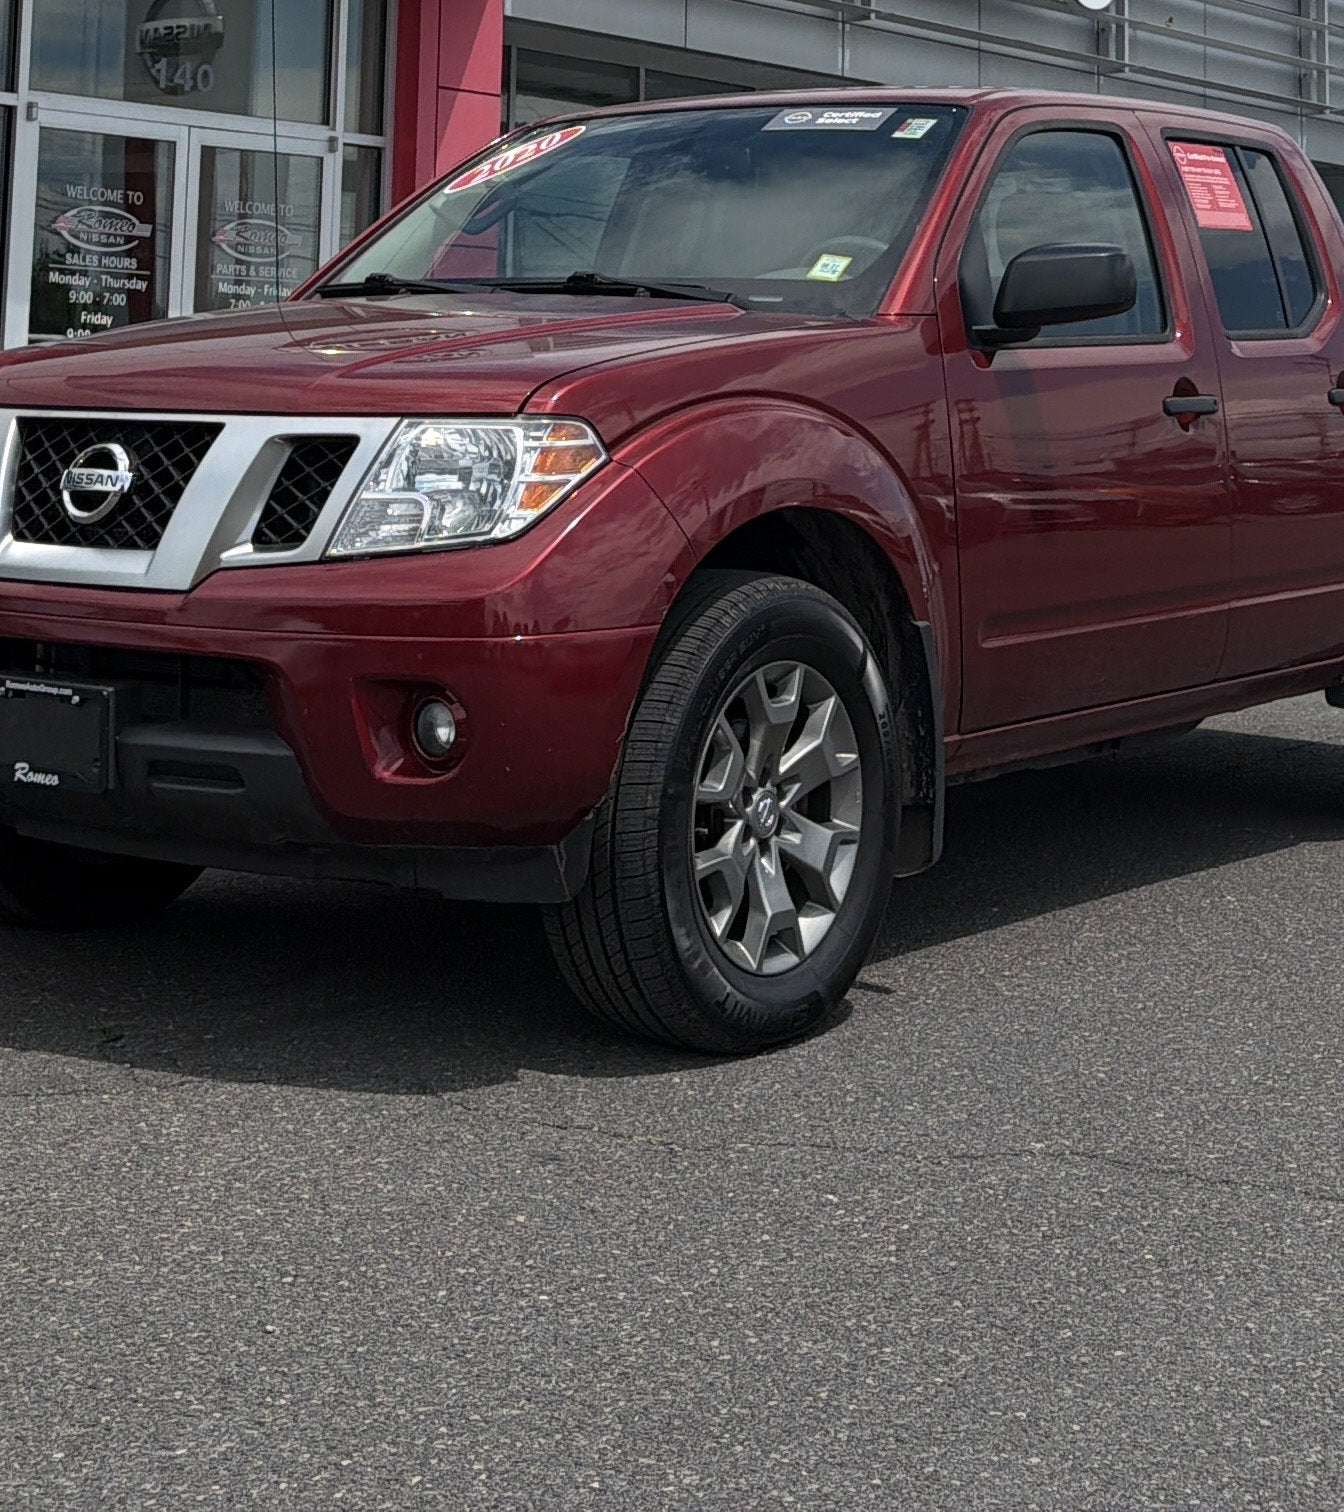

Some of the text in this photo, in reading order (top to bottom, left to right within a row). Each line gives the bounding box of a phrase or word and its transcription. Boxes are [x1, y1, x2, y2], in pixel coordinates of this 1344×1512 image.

[155, 57, 215, 92] 140
[822, 111, 883, 119] Certified
[470, 131, 562, 184] 2020
[66, 184, 143, 206] WELCOME TO
[224, 200, 293, 217] WELCOME TO
[75, 210, 136, 233] Romeo
[79, 231, 125, 245] NISSAN
[65, 253, 137, 269] SALES HOURS
[216, 264, 247, 276] PARTS
[249, 266, 256, 276] &
[48, 271, 91, 288] Monday
[101, 274, 148, 292] Thursday
[218, 281, 256, 298] Monday
[69, 290, 94, 304] 9:00
[102, 292, 127, 306] 7:00
[80, 311, 114, 328] Friday
[64, 470, 120, 488] NISSAN
[14, 762, 59, 786] Romeo
